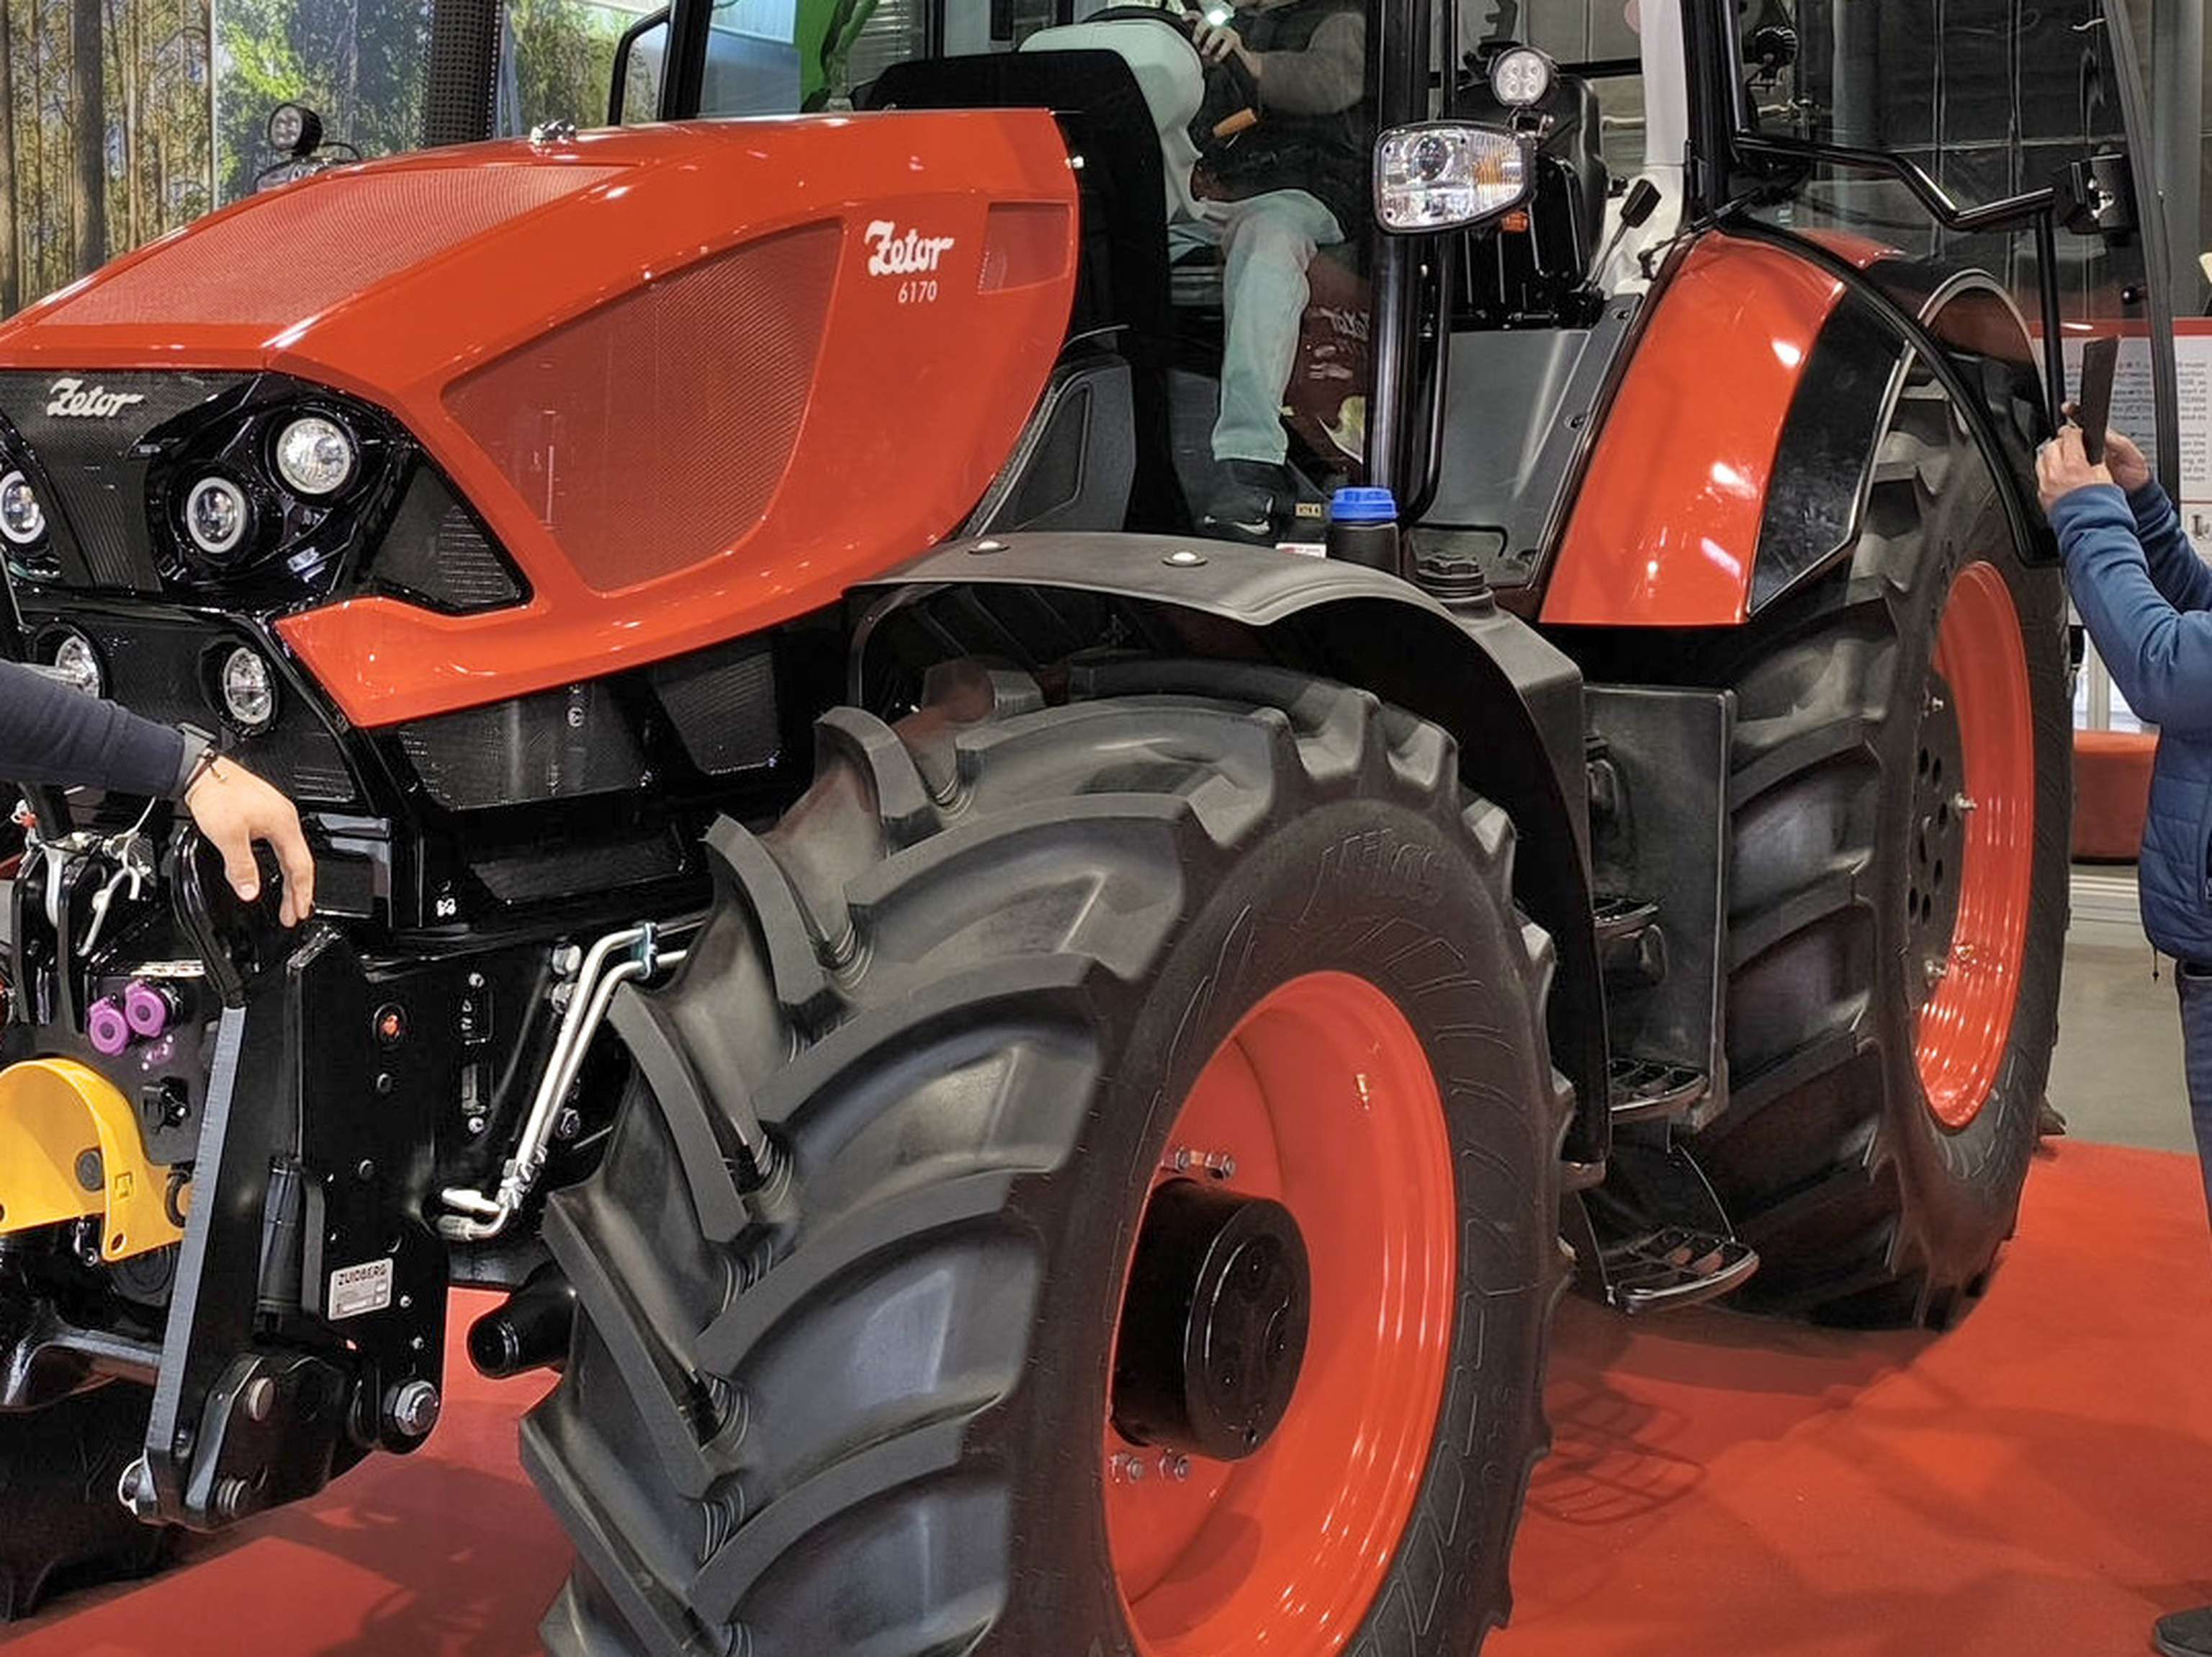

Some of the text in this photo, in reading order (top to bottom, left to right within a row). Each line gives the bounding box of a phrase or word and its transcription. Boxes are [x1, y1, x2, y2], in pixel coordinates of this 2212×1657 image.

[864, 220, 954, 276] Zetor
[898, 280, 938, 303] 6170
[46, 377, 144, 417] Zetor
